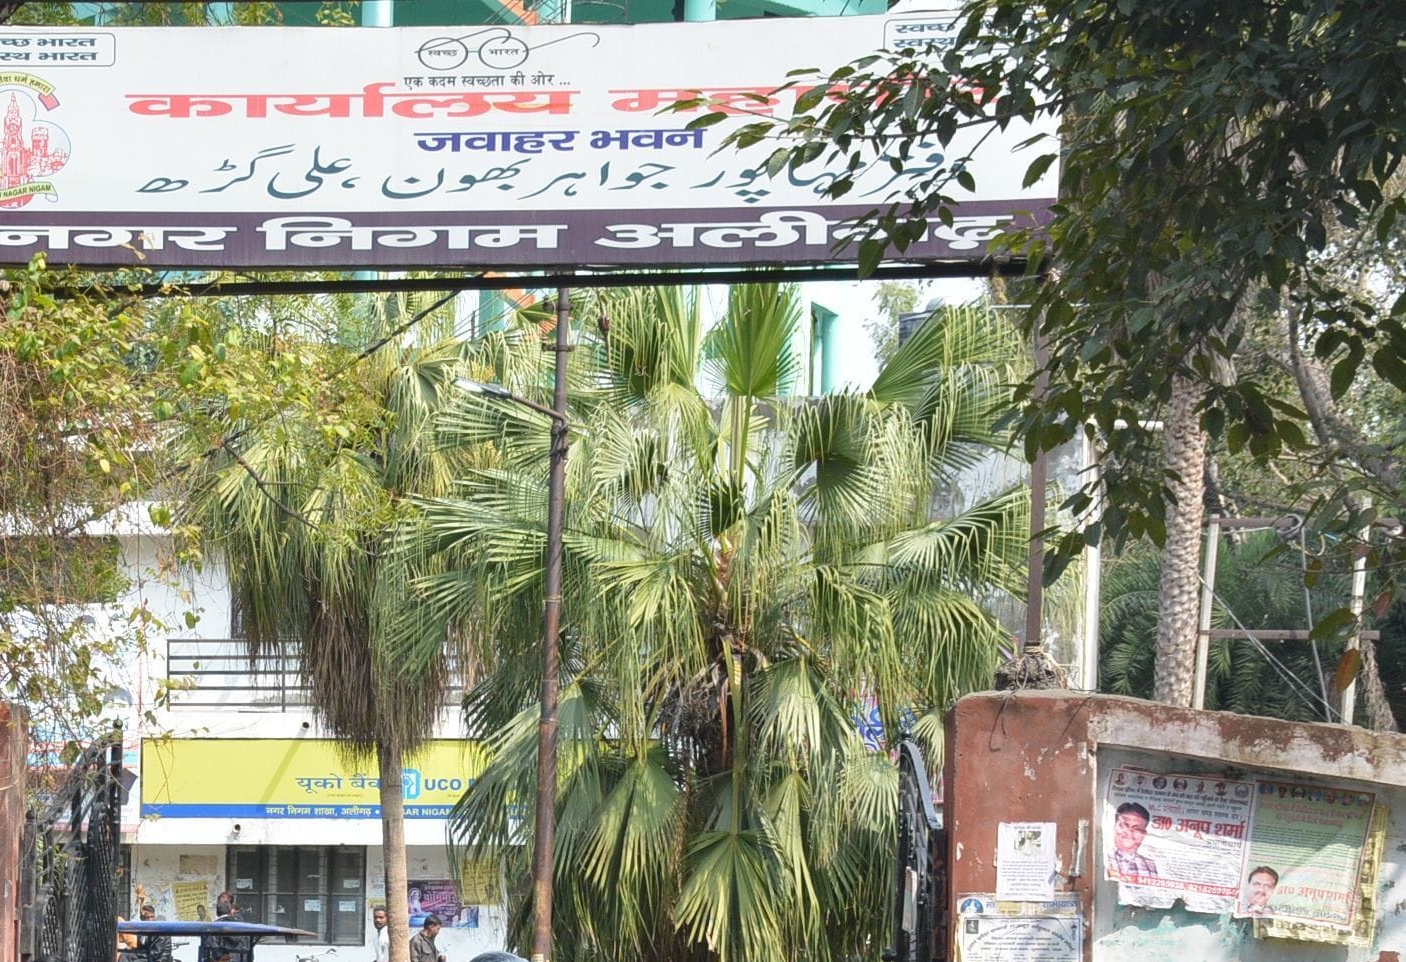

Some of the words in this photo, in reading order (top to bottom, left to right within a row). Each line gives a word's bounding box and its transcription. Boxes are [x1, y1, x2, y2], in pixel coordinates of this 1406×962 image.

[37, 37, 96, 47] भारत
[38, 51, 98, 61] भारत
[404, 77, 423, 90] एक
[428, 76, 456, 88] कदम
[461, 75, 505, 87] स्वच्छता
[510, 71, 526, 85] की
[530, 70, 555, 85] ओर
[125, 82, 581, 119] कार्यालय
[414, 130, 580, 153] जवाहर
[590, 129, 707, 152] भवन
[3, 187, 28, 197] NAGAR
[28, 184, 52, 193] NIGAM
[256, 216, 568, 250] निगम
[295, 773, 343, 794] यूको
[424, 778, 462, 791] UCO
[266, 806, 285, 816] नगर
[288, 804, 311, 816] निगम
[1175, 818, 1212, 840] अनूप
[1215, 820, 1246, 839] शर्मा
